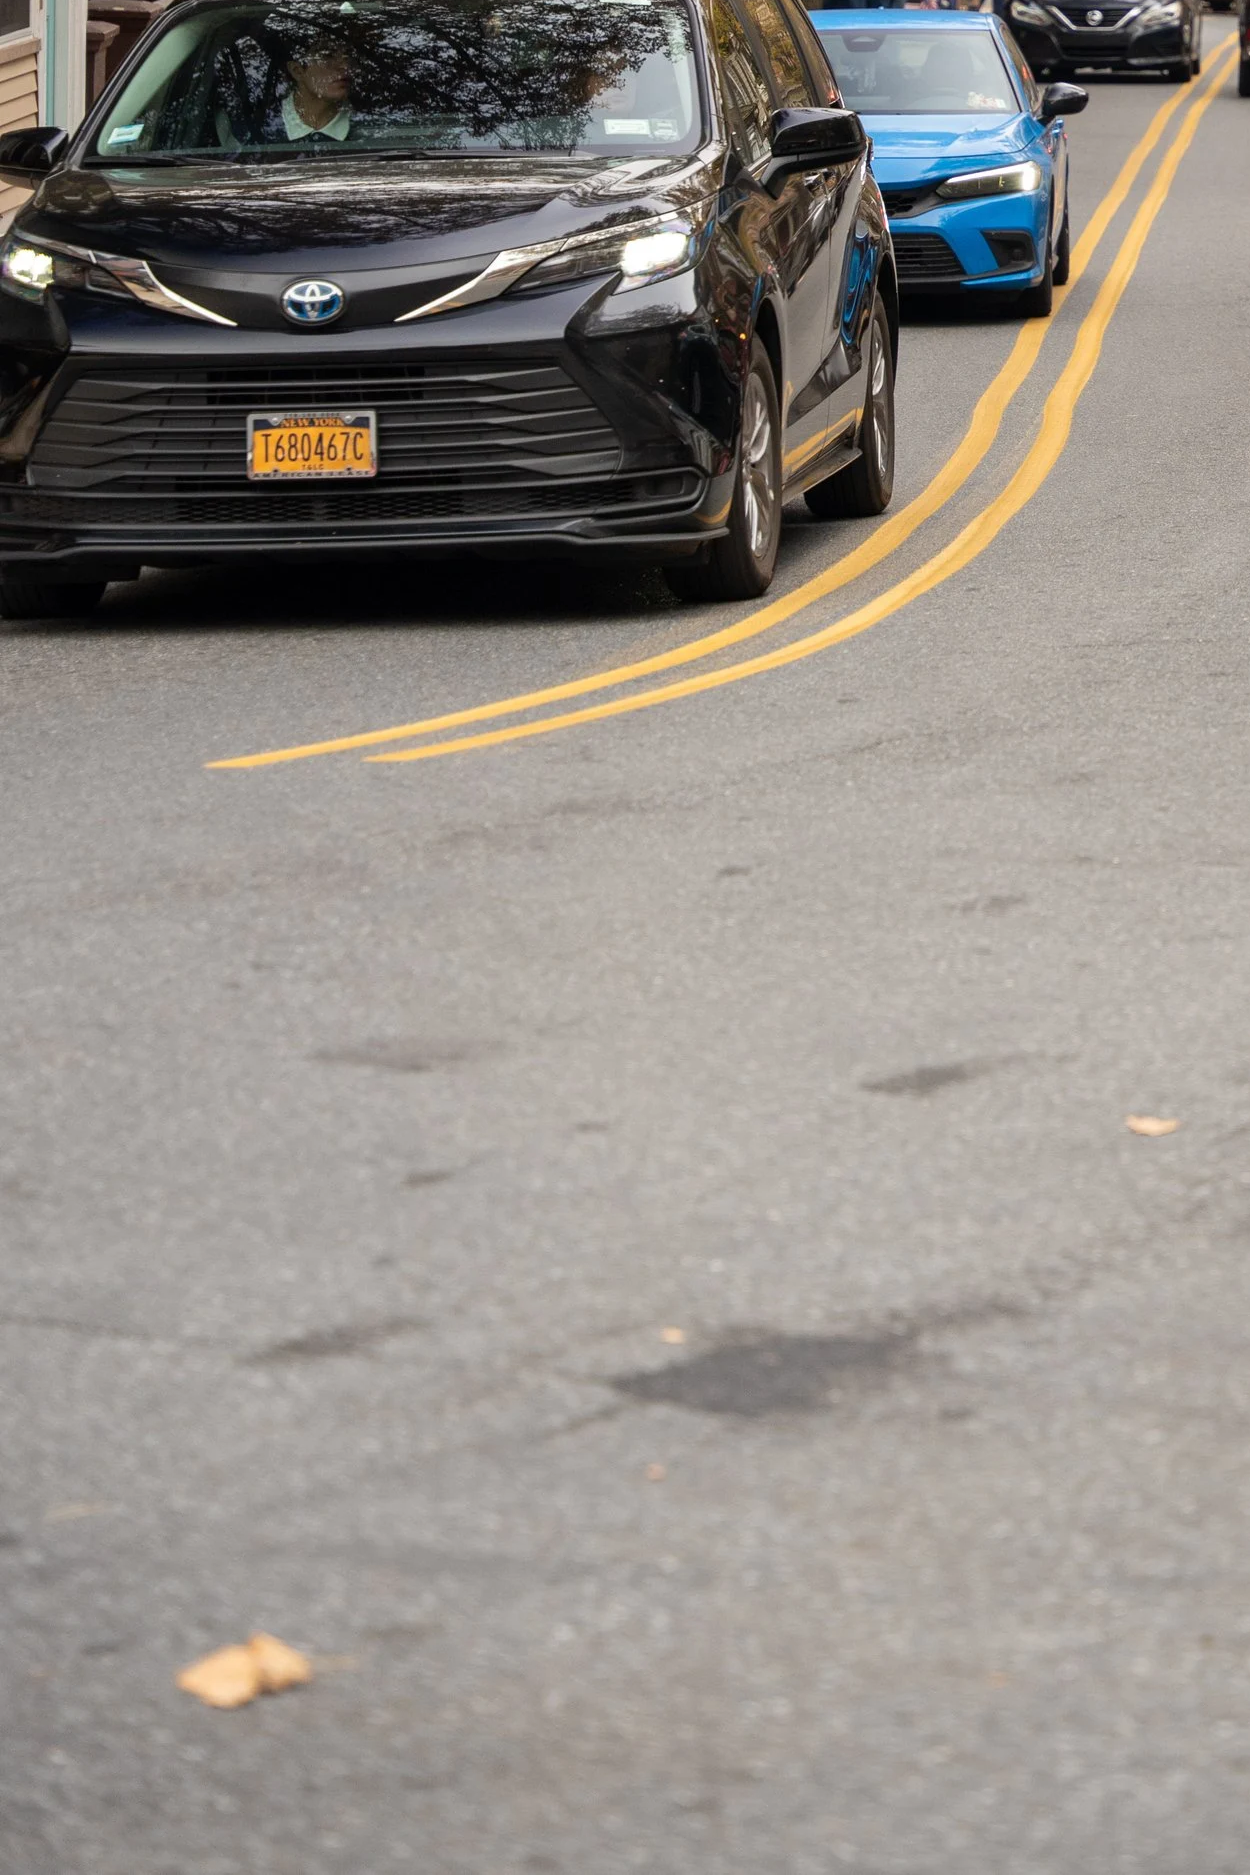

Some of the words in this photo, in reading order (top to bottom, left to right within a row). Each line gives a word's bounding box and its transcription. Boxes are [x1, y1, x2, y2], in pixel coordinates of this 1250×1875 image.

[281, 418, 311, 427] NEW
[314, 417, 345, 427] YORK
[261, 431, 364, 462] T680467C
